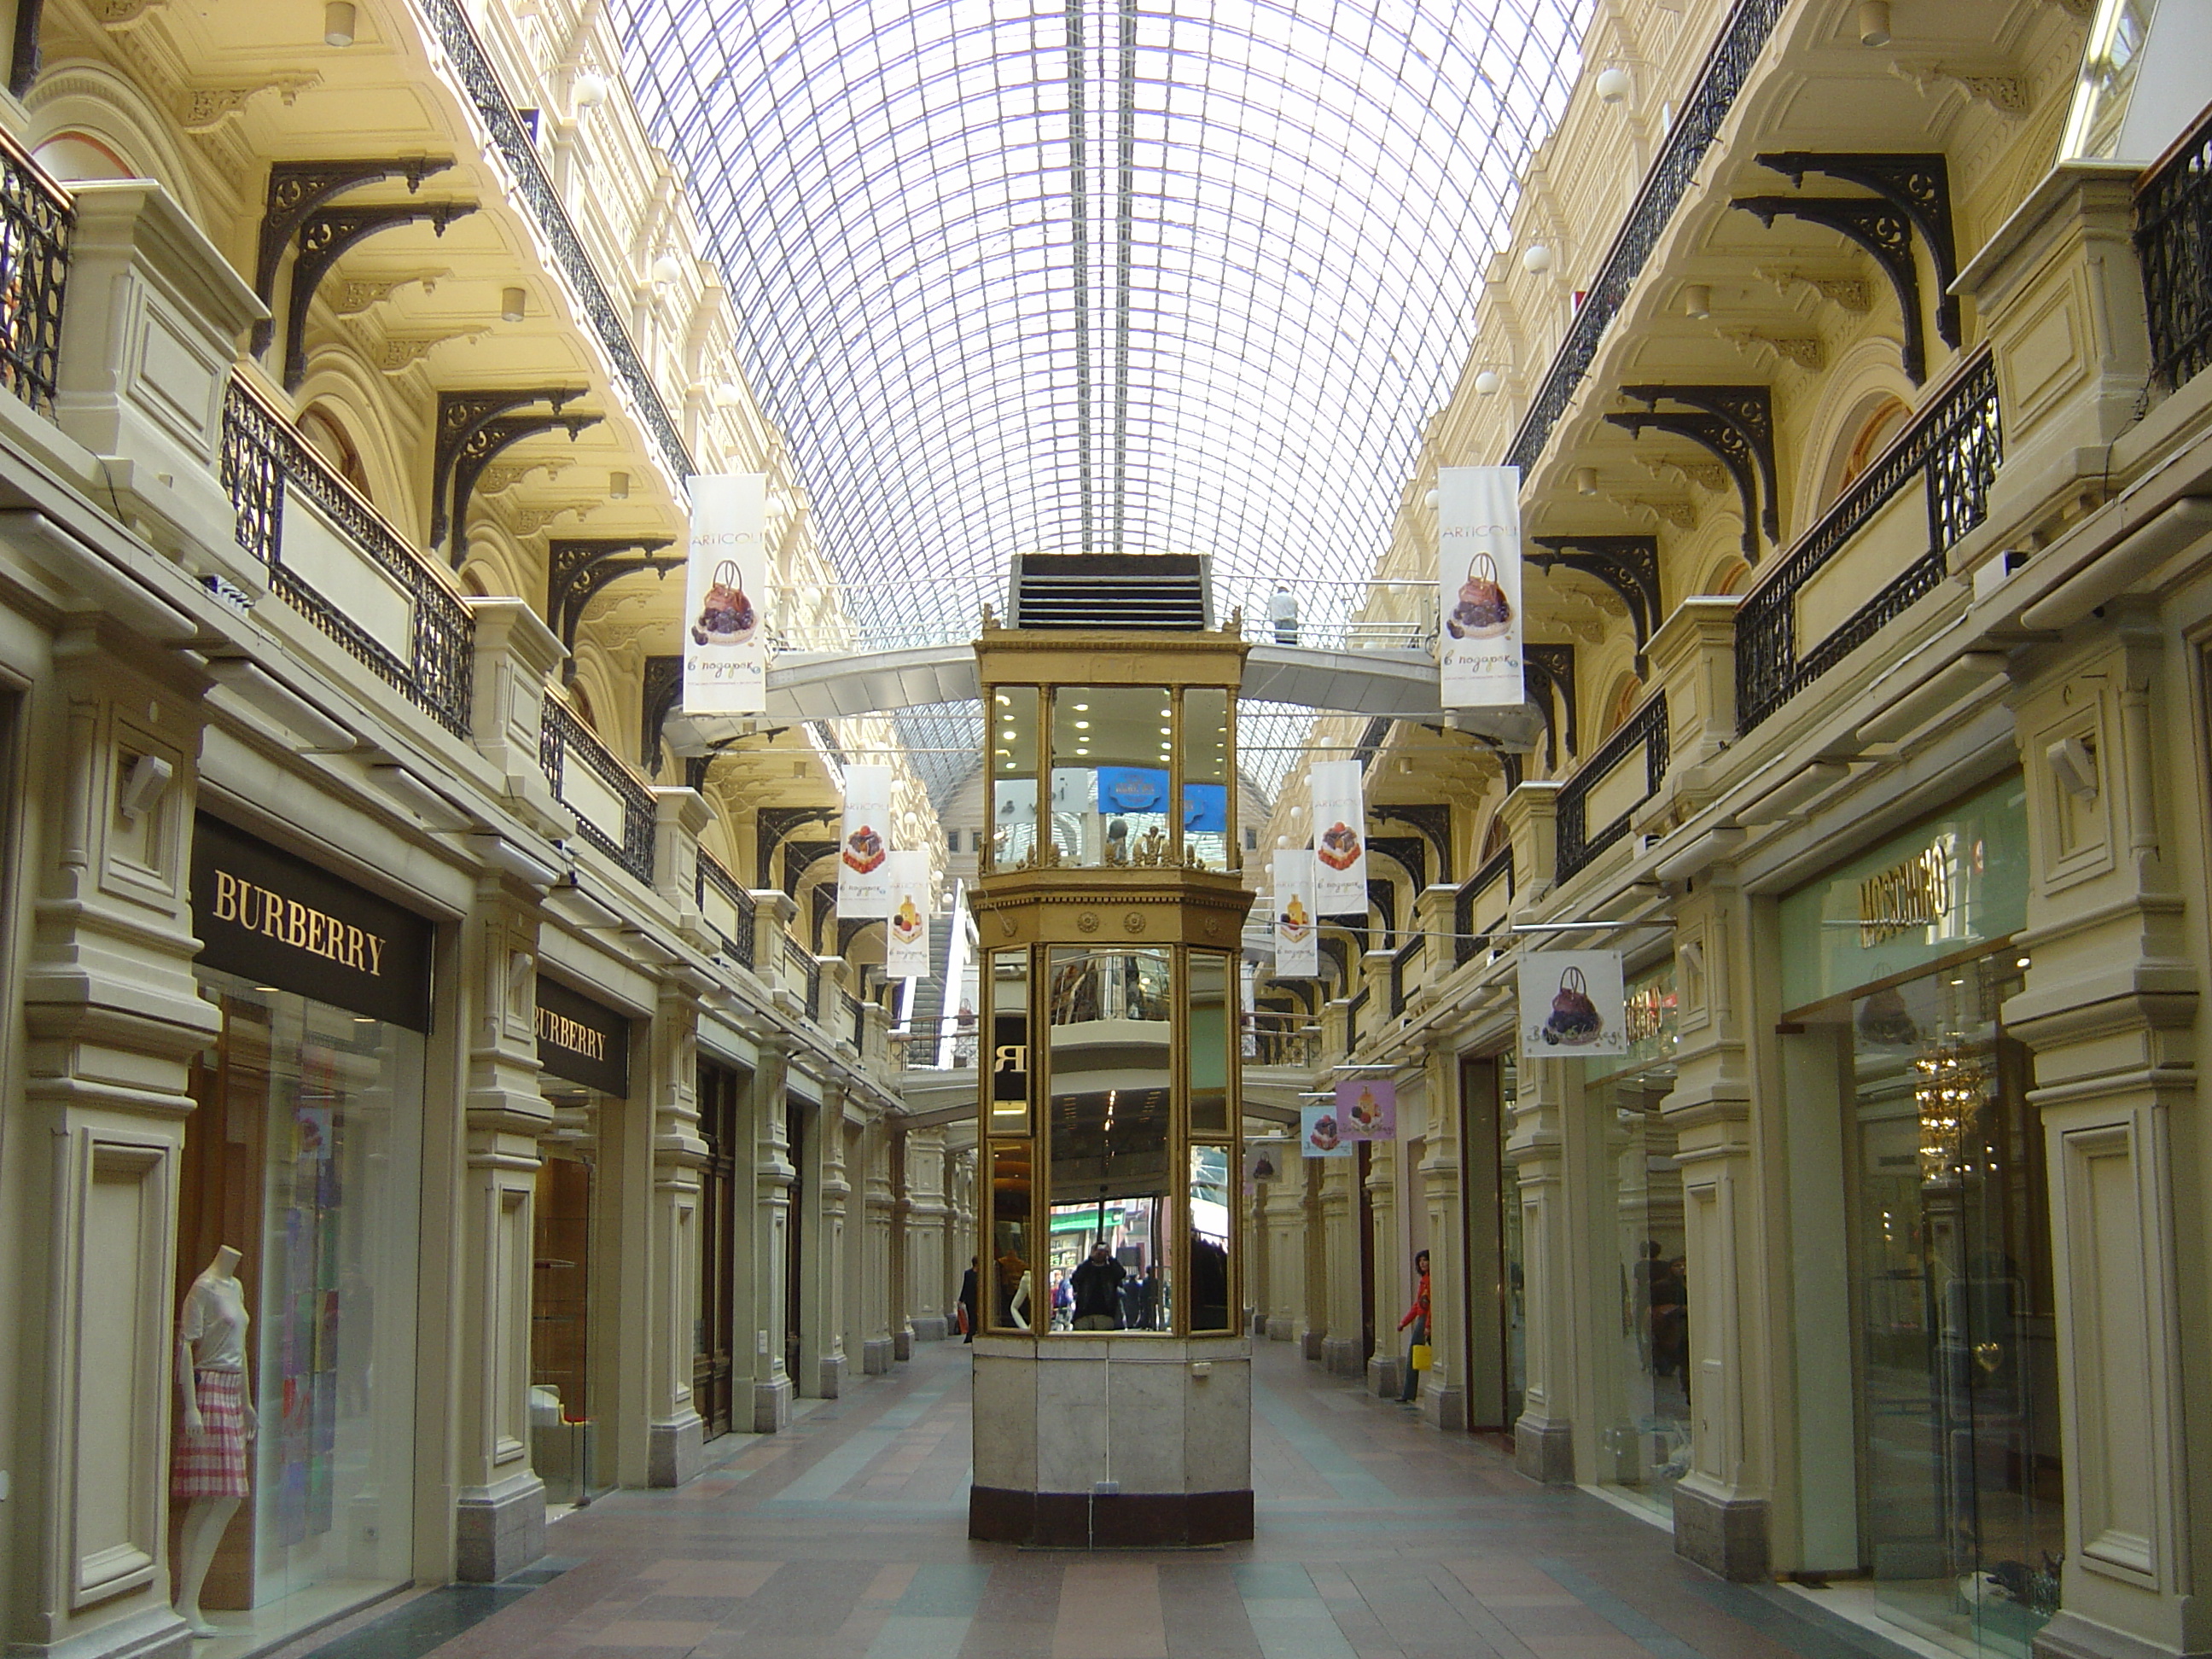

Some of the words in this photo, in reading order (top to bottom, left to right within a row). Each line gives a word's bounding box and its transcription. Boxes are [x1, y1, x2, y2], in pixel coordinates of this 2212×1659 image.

[691, 533, 762, 545] ARTICOLI
[1442, 525, 1516, 538] ARTICOLI
[212, 868, 386, 976] BURBERRY
[1859, 844, 1947, 948] MOSCHINO
